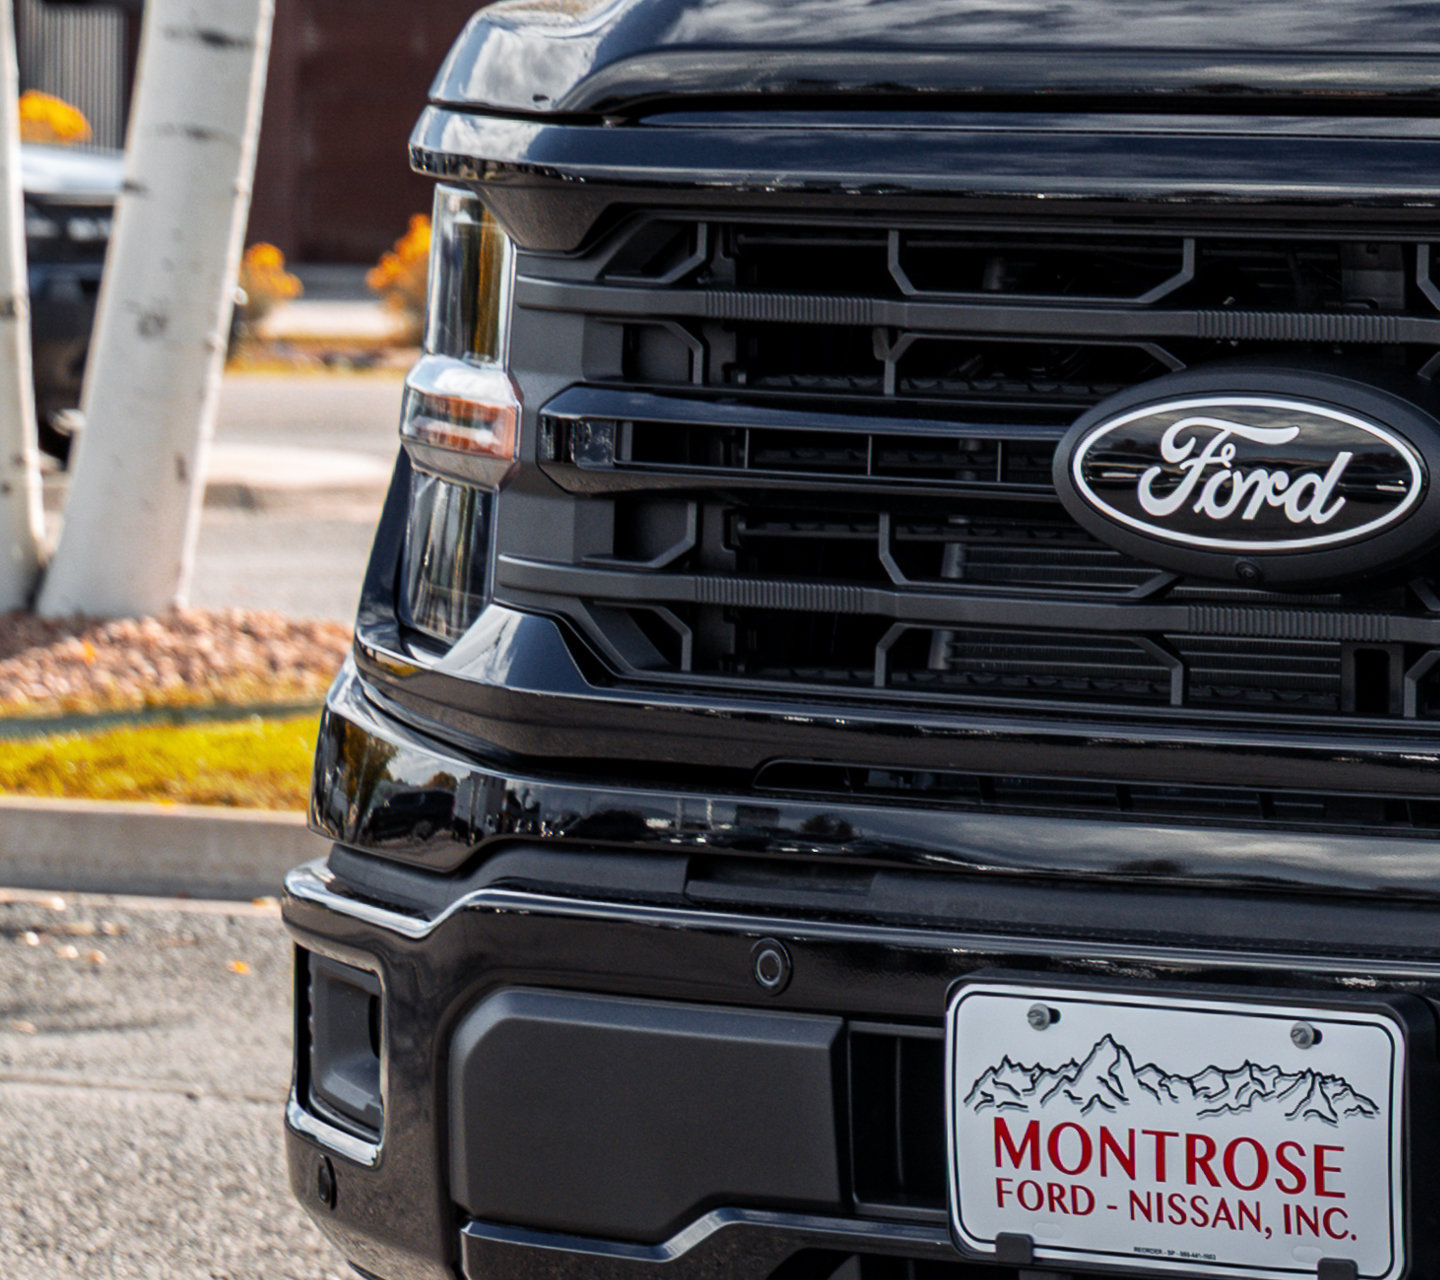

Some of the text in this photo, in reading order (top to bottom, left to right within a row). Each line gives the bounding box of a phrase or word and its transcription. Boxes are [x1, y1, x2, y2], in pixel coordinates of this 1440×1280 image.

[1136, 416, 1354, 525] Ford
[993, 1116, 1347, 1199] MONTROSE
[995, 1176, 1095, 1217] FORD
[1129, 1189, 1273, 1240] NISSAN,
[1283, 1203, 1358, 1241] INC.
